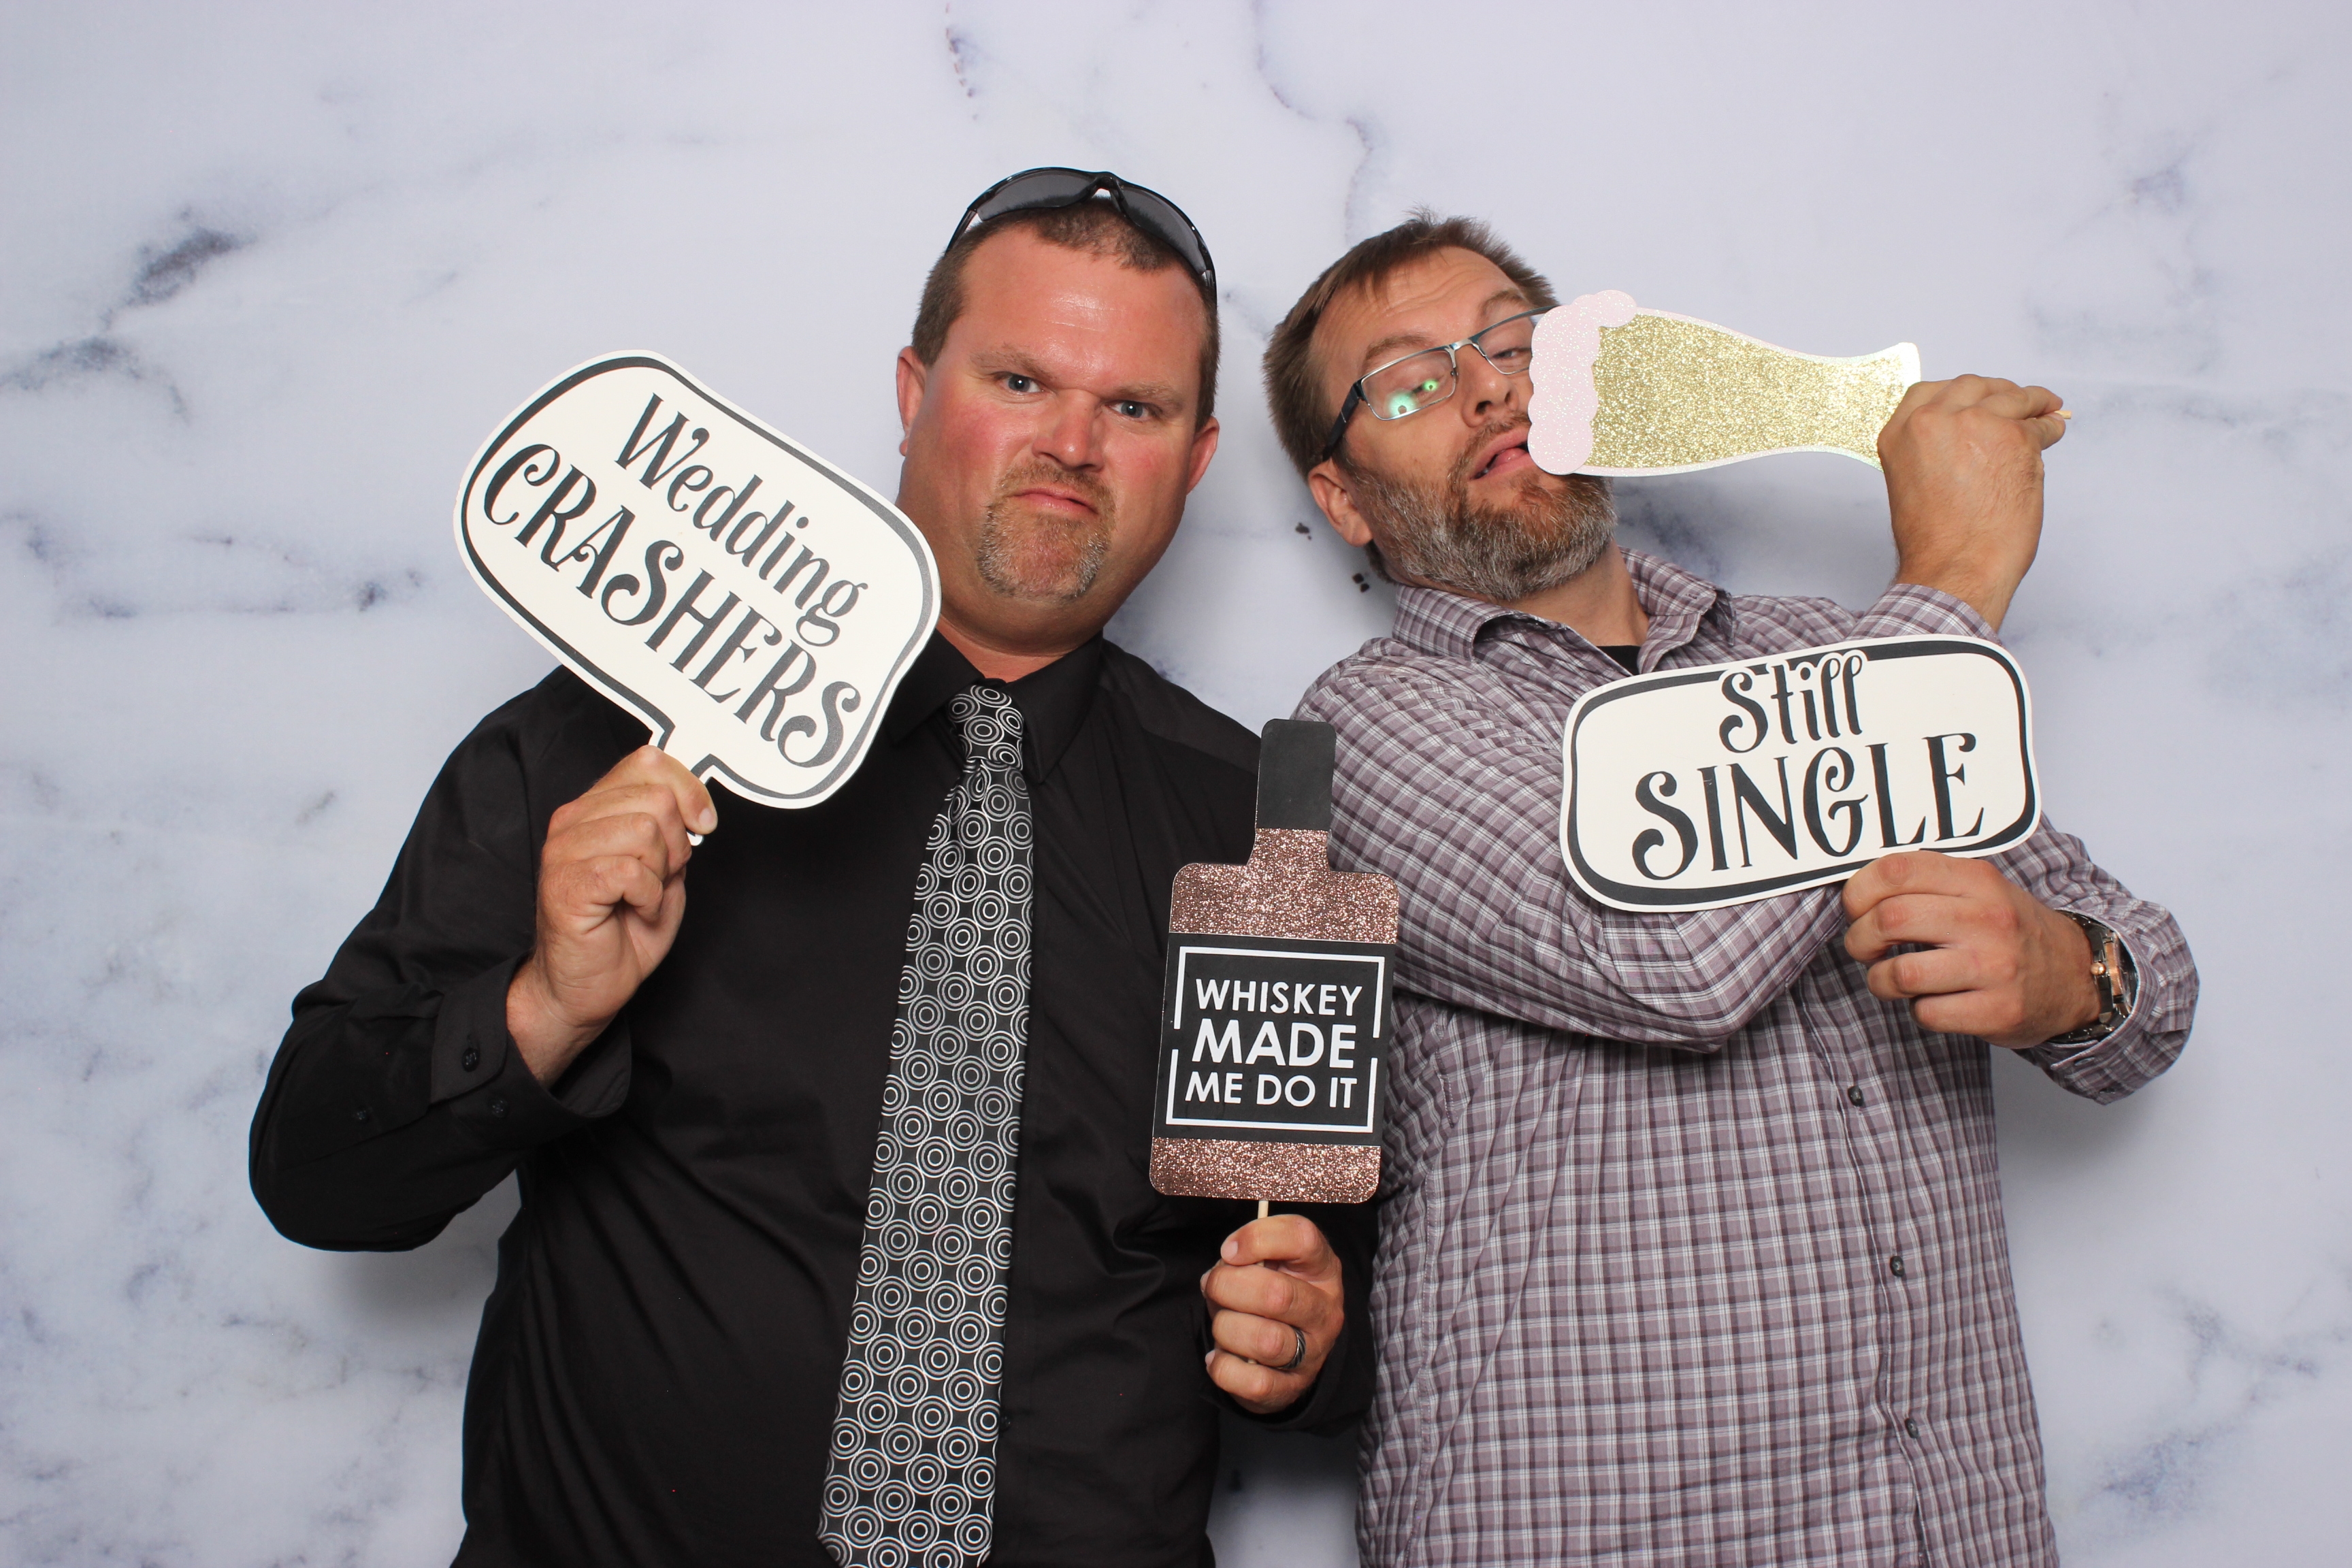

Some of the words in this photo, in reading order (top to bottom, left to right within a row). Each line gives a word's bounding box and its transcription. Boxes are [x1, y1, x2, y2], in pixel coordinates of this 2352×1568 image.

[615, 393, 868, 647] Wedding
[484, 444, 862, 768] CRASHERS
[1719, 652, 1863, 753] Still
[1632, 732, 1985, 881] SINGLE
[1192, 1018, 1357, 1069] MADE
[1195, 978, 1363, 1016] WHISKEY
[1184, 1071, 1243, 1105] ME
[1256, 1074, 1316, 1107] DO
[1329, 1077, 1358, 1109] IT
